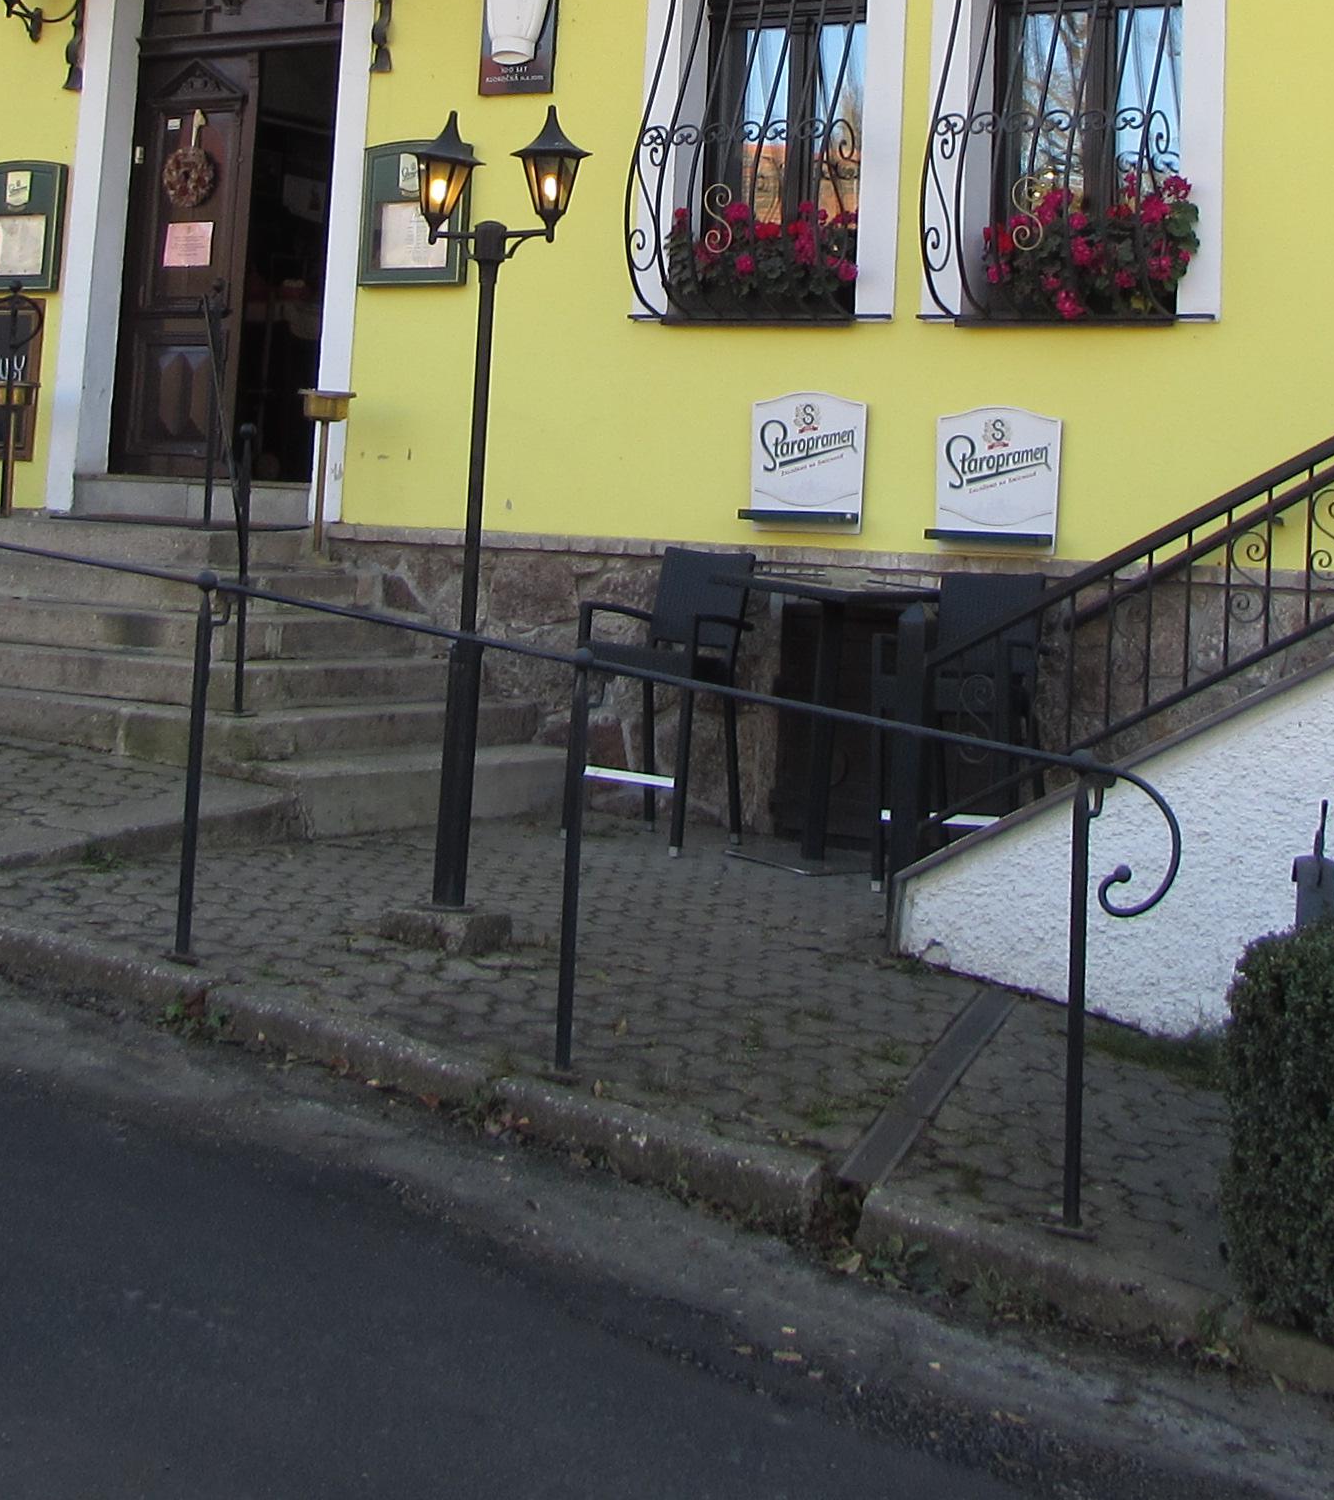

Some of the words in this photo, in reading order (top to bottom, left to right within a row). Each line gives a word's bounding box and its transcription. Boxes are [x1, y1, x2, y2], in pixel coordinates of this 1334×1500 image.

[802, 404, 815, 426] S
[991, 418, 1005, 442] S
[760, 419, 857, 472] Staropramen
[945, 433, 1052, 489] Staropramen
